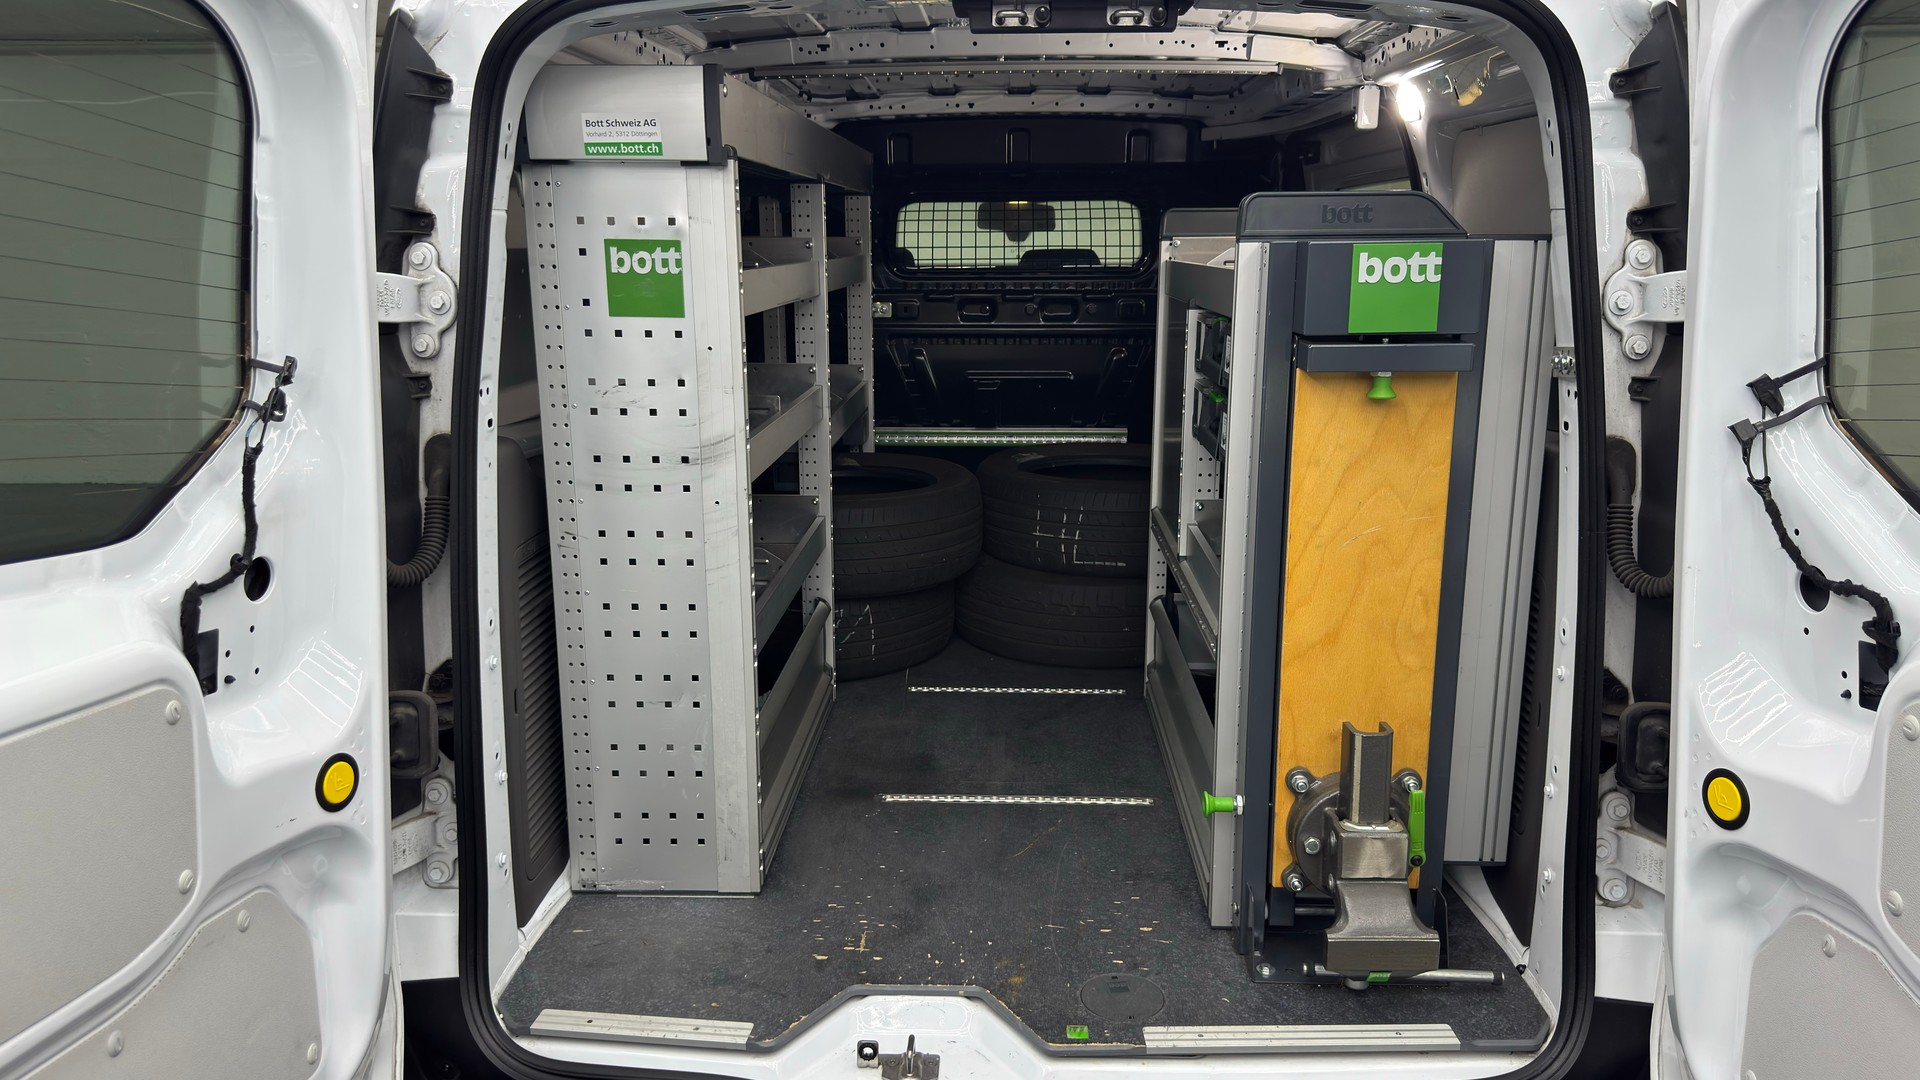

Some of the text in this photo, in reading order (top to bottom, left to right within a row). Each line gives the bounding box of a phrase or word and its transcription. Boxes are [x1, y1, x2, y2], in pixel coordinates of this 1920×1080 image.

[585, 118, 657, 127] Bott Schweiz AG
[587, 143, 660, 153] www.bott.ch
[1321, 203, 1374, 224] bott
[609, 246, 682, 274] bott
[1358, 251, 1443, 283] bott
